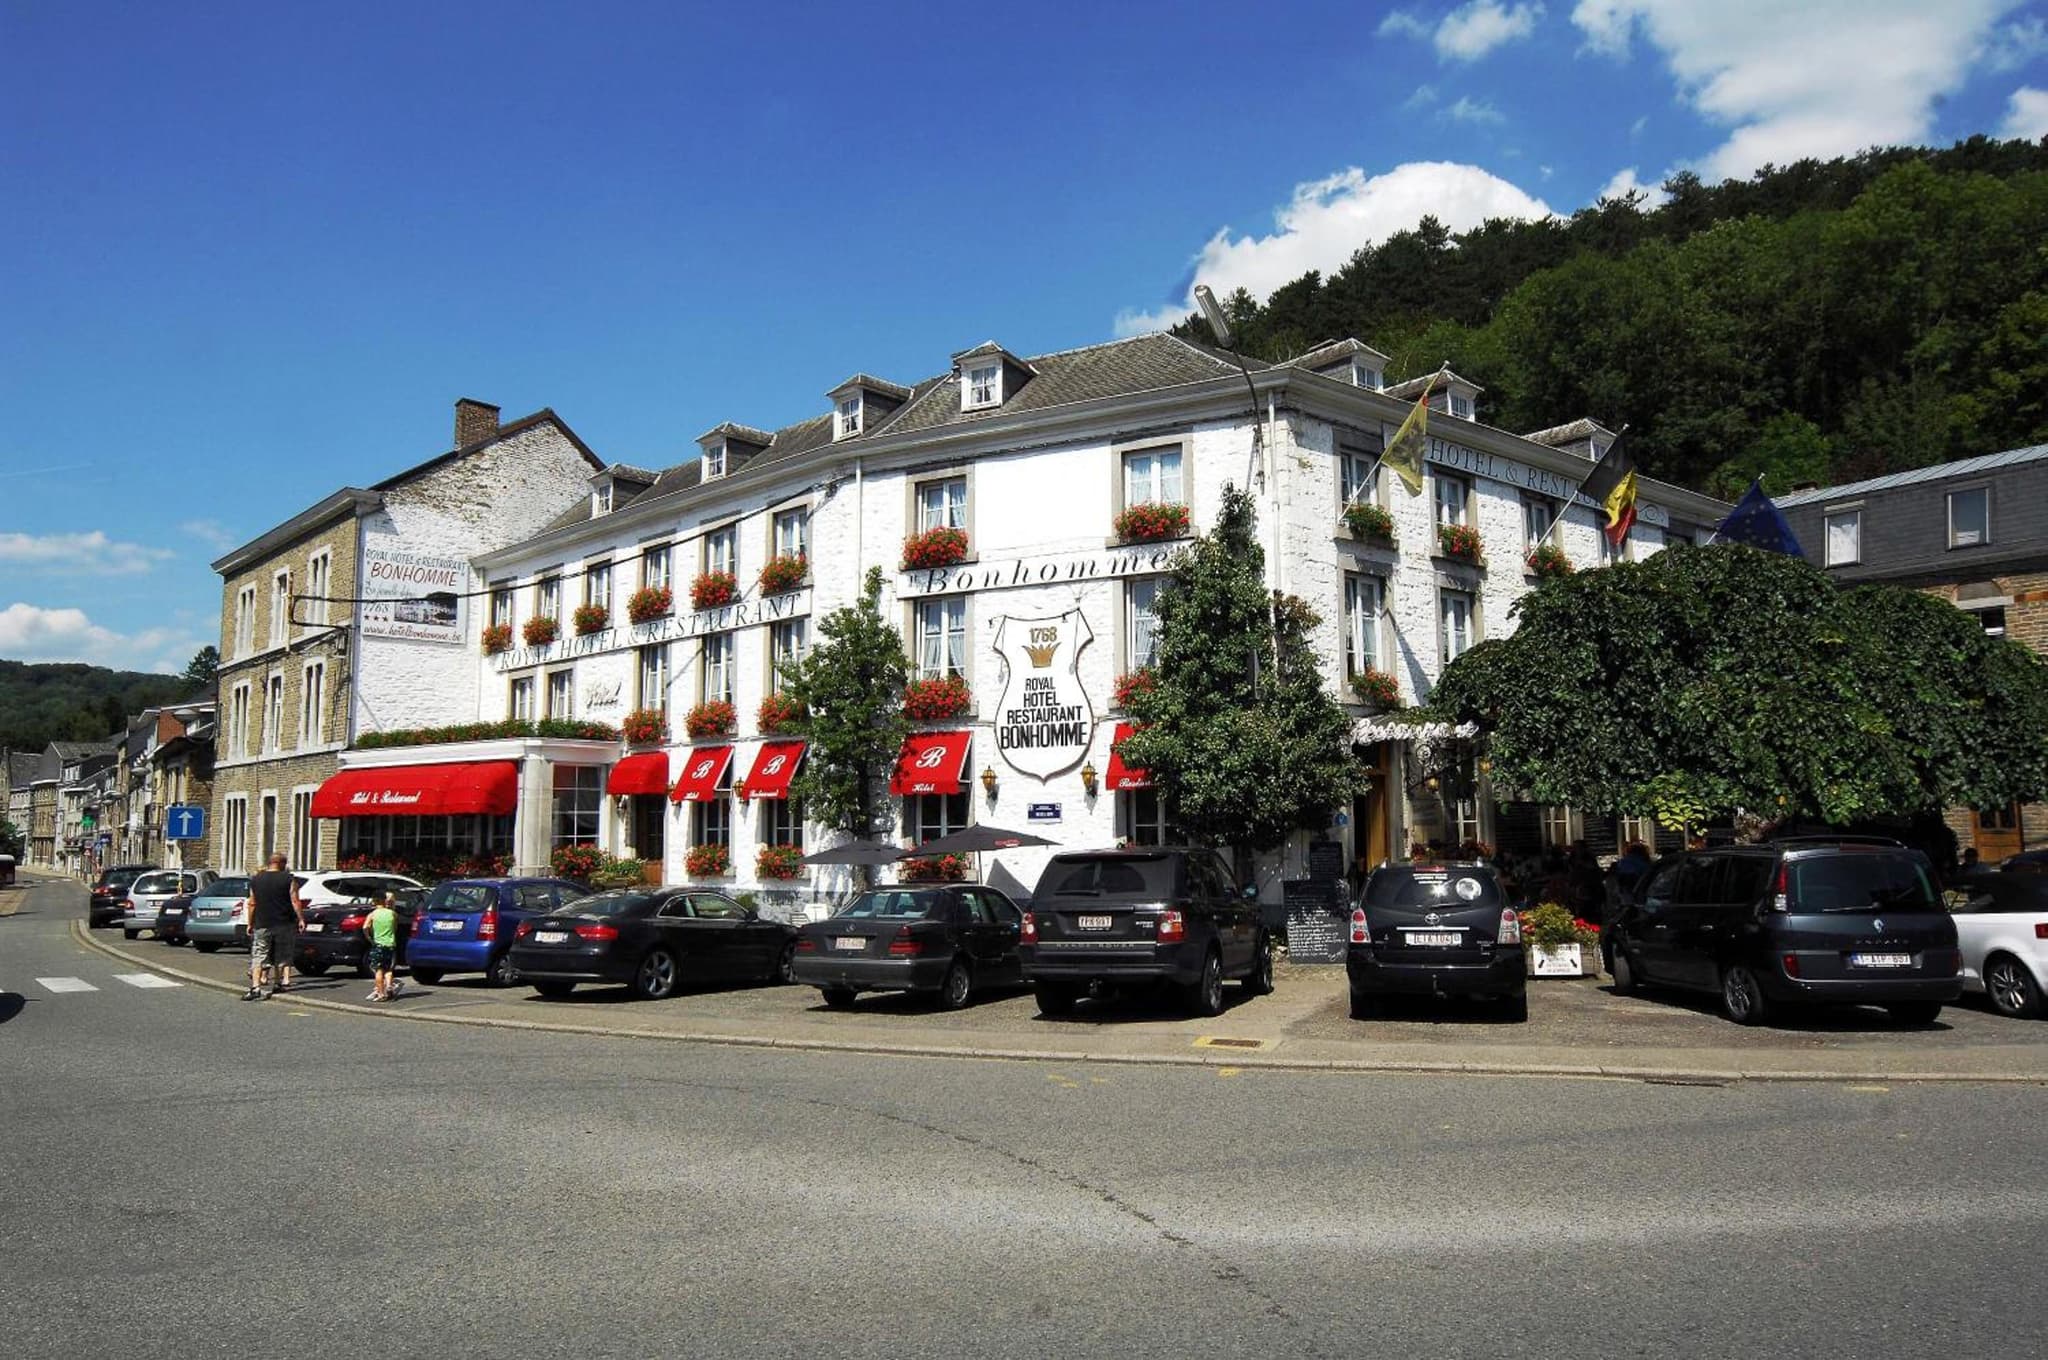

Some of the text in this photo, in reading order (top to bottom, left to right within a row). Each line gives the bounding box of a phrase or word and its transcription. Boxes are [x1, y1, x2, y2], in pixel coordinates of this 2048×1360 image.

[1430, 438, 1498, 478] HOTEL
[1505, 461, 1520, 482] &
[371, 561, 458, 587] BONHOMME
[500, 643, 553, 670] ROYAL
[560, 629, 621, 658] HOTEL
[646, 593, 801, 643] RESTAURANT
[1029, 626, 1057, 643] 1768
[1025, 677, 1056, 691] ROYAL
[1023, 691, 1061, 708] HOTEL
[1007, 705, 1083, 725] RESTAURANT
[1000, 721, 1087, 750] BONHOMME
[916, 746, 947, 768] B
